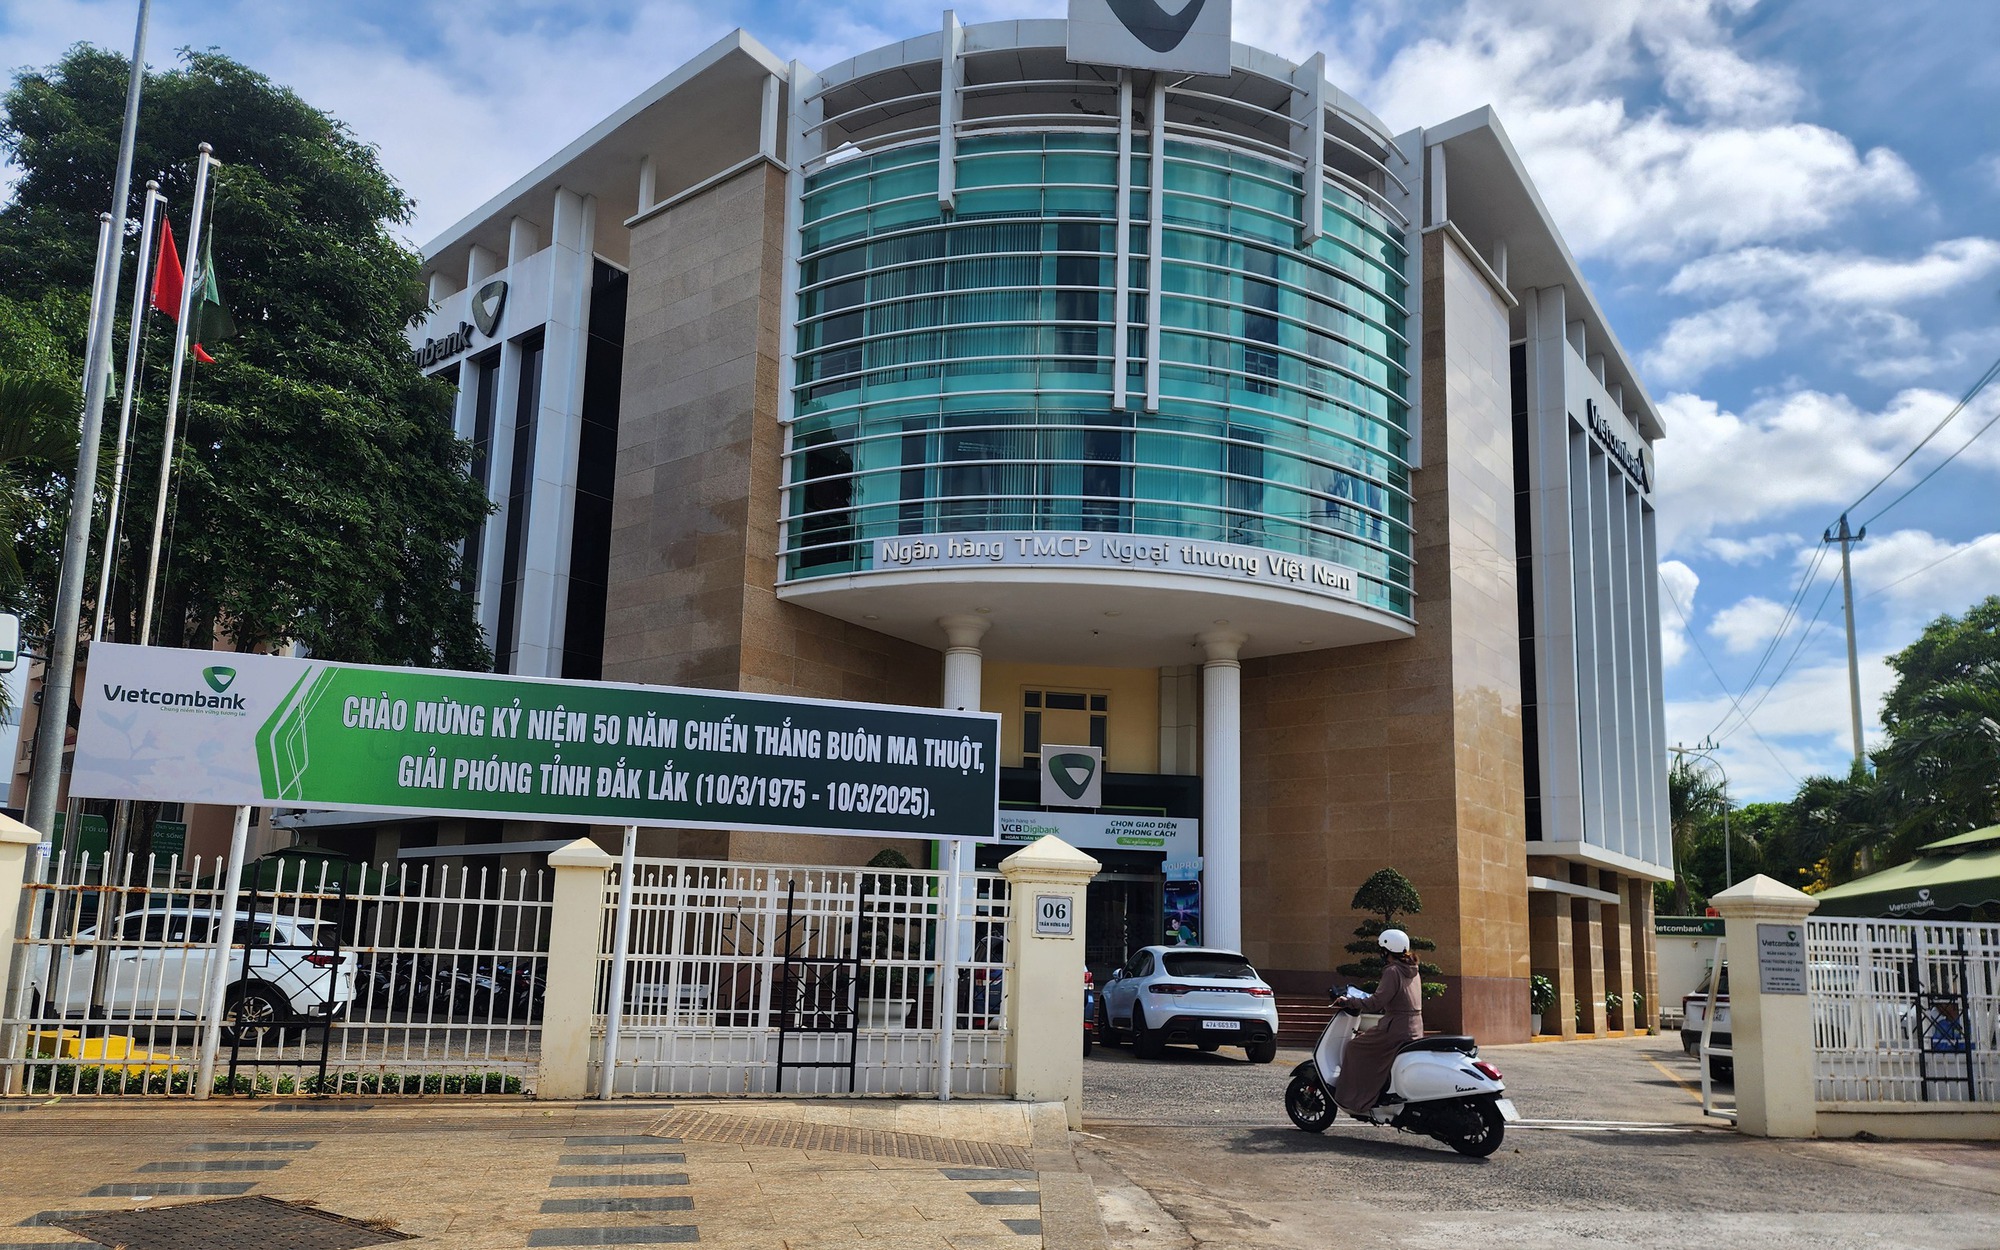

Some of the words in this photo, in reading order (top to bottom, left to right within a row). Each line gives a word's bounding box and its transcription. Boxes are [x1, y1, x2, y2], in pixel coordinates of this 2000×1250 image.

[882, 540, 939, 564] Ngân
[948, 537, 1004, 561] hàng
[1014, 536, 1092, 558] TMCP
[1102, 538, 1170, 565] Ngoại
[1180, 545, 1260, 576] thương
[1267, 554, 1306, 583] Việt
[1312, 563, 1352, 590] Nam
[103, 684, 246, 710] Vietcombank
[342, 691, 408, 731] CHÀO
[414, 696, 485, 737] MỪNG
[491, 697, 523, 739] KỶ
[527, 704, 587, 749] NIỆM
[593, 713, 621, 745] 50
[626, 710, 678, 749] NĂM
[684, 714, 748, 754] CHIẾN
[754, 717, 821, 760] THẮNG
[826, 727, 881, 763] BUÔN
[887, 735, 918, 766] MA
[923, 735, 985, 776] THUỘT,
[398, 746, 447, 789] GIẢI
[452, 753, 533, 794] PHÓNG
[540, 753, 592, 797] TỈNH
[597, 756, 643, 800] ĐẮK
[647, 759, 690, 803] LẮK
[696, 773, 806, 809] (10/3/1975
[811, 793, 820, 801] -
[826, 782, 935, 819] 10/3/2025).
[1001, 824, 1022, 832] VCB
[1023, 824, 1060, 834] Digibank
[1154, 829, 1177, 837] CÁCH
[1158, 821, 1177, 829] DIỆN
[1043, 903, 1066, 919] 06
[1889, 898, 1935, 911] Vietcombank
